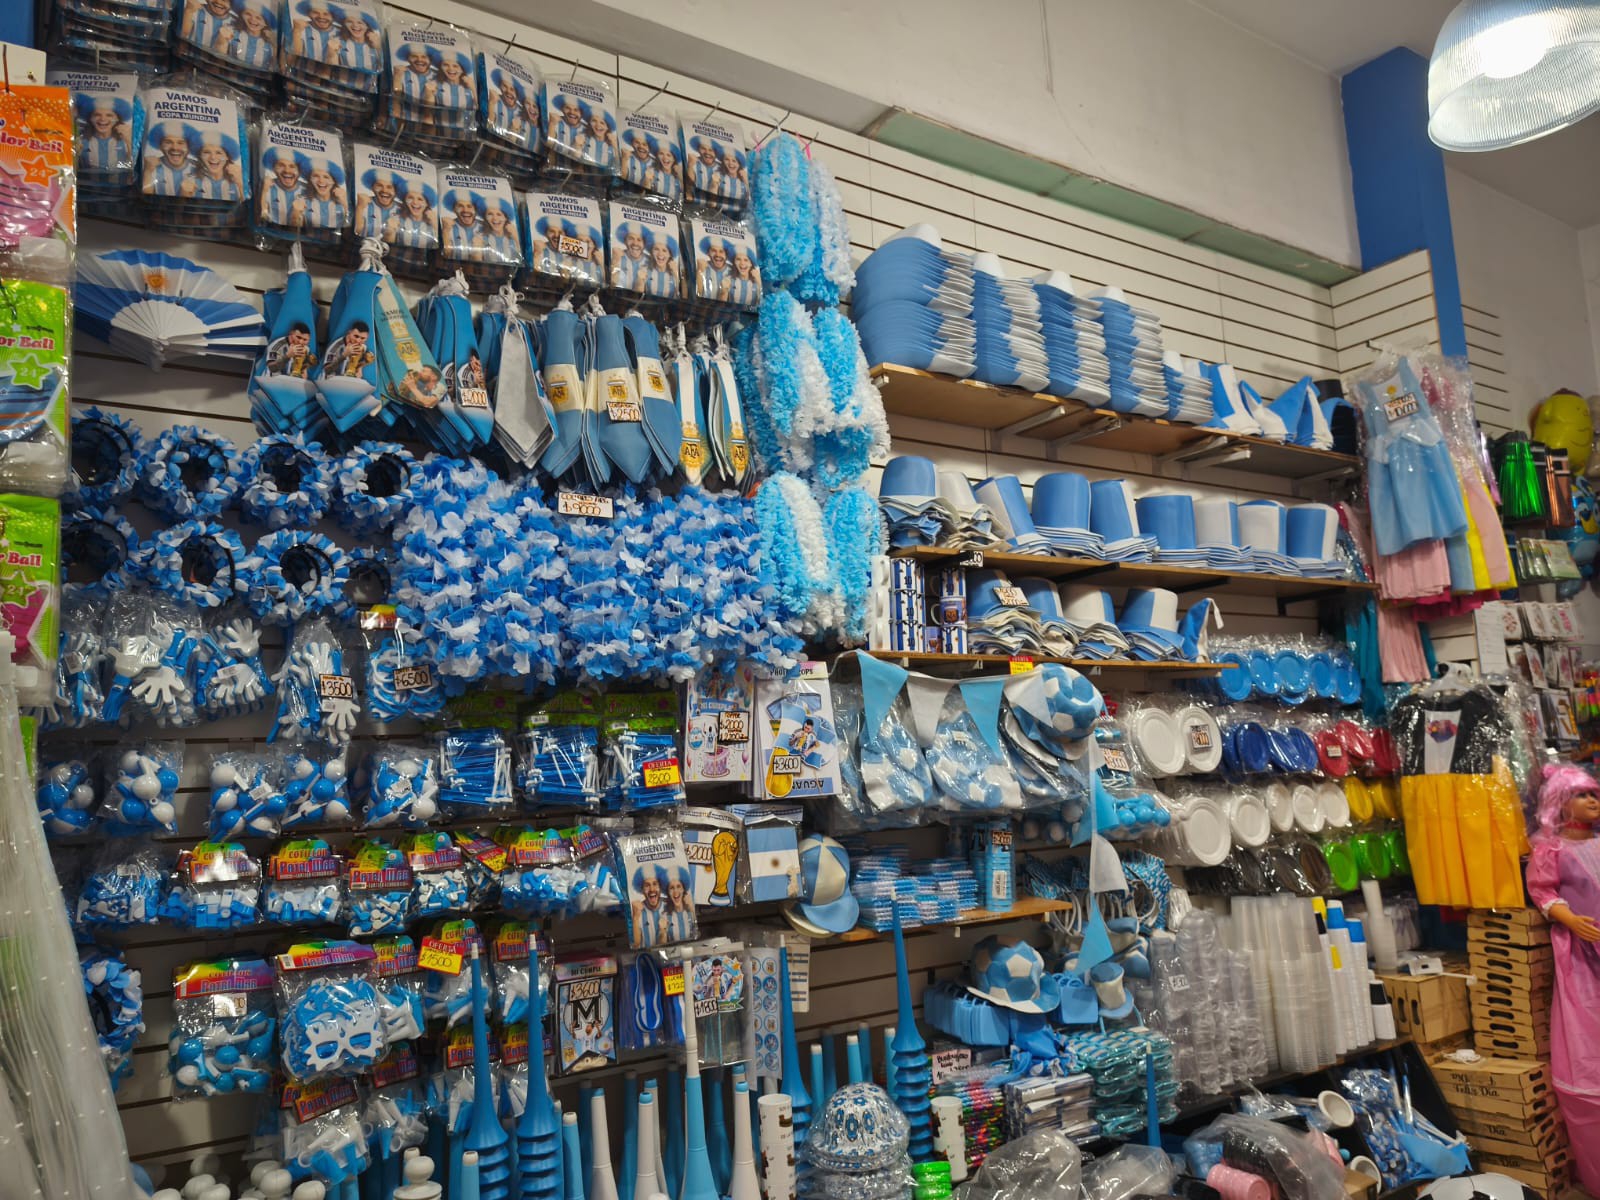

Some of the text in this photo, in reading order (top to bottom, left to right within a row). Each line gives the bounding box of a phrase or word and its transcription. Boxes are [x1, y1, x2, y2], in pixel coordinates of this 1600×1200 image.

[67, 73, 109, 81] VAMOS
[53, 80, 120, 88] ARGENTINA
[166, 92, 207, 104] VAMOS
[154, 102, 221, 116] ARGENTINA
[182, 114, 215, 123] MUNDIAL
[278, 125, 314, 137] VAMOS
[267, 129, 326, 147] ARGENTINA
[368, 153, 423, 170] ARGENTINA
[378, 150, 412, 162] VAMOS
[30, 167, 46, 178] 24
[445, 174, 497, 184] ARGENTINA
[548, 196, 578, 204] VAMOS
[539, 201, 589, 213] ARGENTINA
[621, 207, 667, 221] ARGENTINA
[19, 336, 54, 350] Ball
[20, 367, 37, 378] 24
[685, 443, 700, 458] AFA
[734, 445, 745, 460] AFA
[7, 551, 42, 567] Ball
[905, 576, 913, 586] 10
[906, 607, 914, 617] 10
[322, 680, 352, 696] $3500
[648, 760, 672, 769] OFERTA
[774, 757, 799, 771] $3600
[525, 839, 559, 848] COTILLON
[633, 843, 676, 855] ARGENTINA
[289, 849, 328, 859] COTILLON
[379, 944, 413, 956] OTILLON
[429, 940, 457, 953] OFERTA
[421, 953, 453, 968] $1500
[571, 981, 600, 999] $3600
[572, 998, 602, 1030] M
